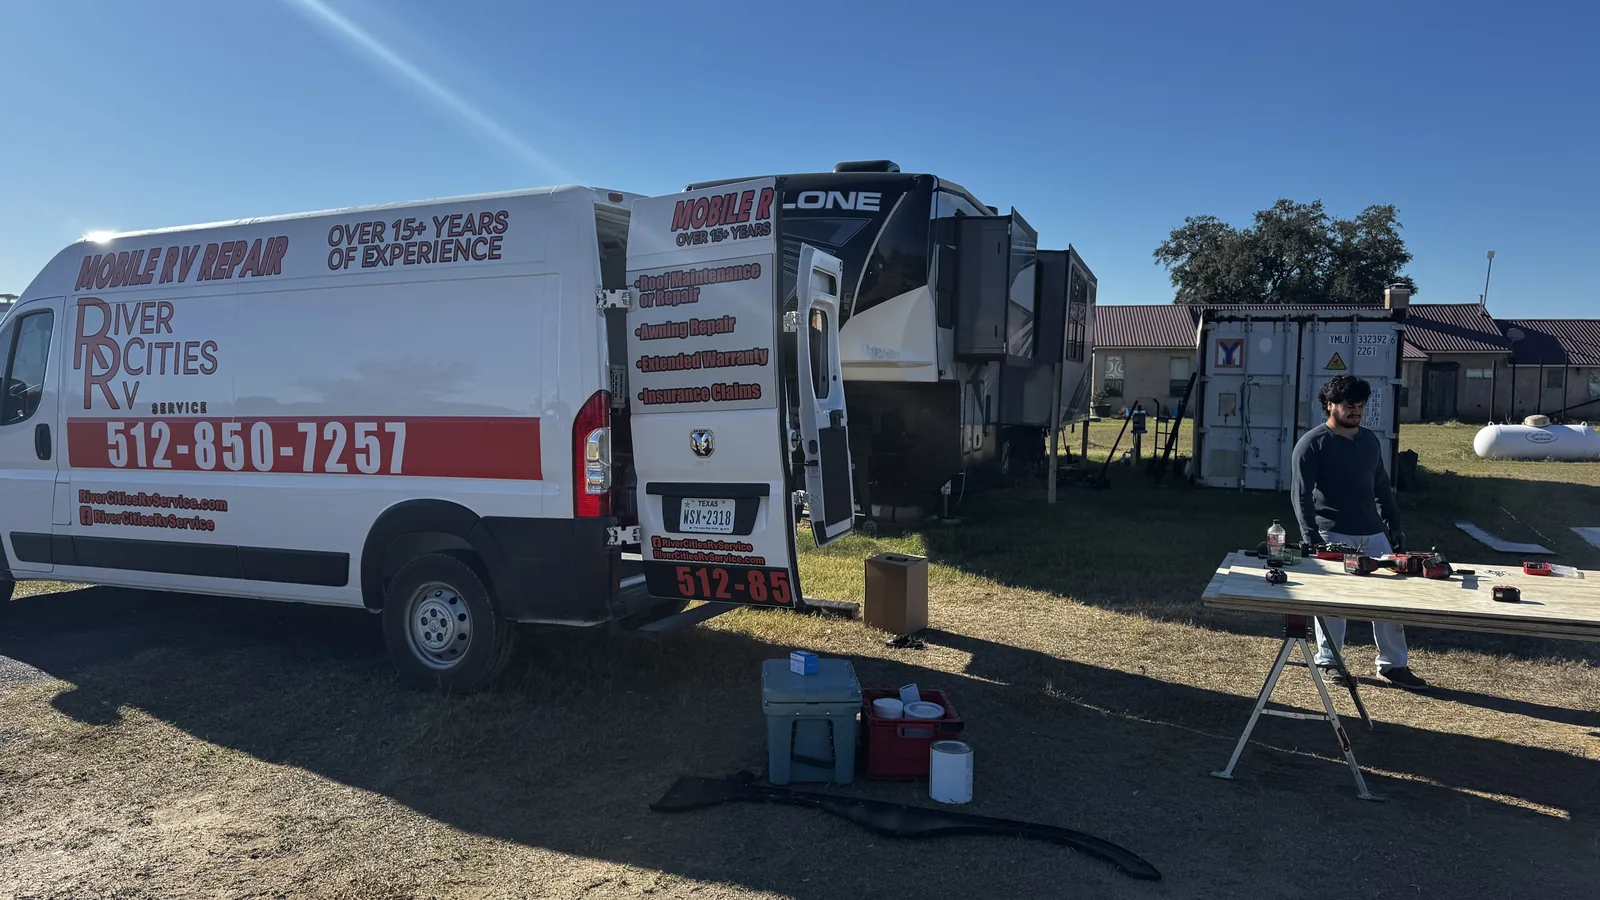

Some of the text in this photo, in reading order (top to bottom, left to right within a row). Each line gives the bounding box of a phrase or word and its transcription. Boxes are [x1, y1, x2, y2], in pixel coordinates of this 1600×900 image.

[671, 187, 775, 232] MOBILE R
[328, 210, 509, 247] OVER 15+ YEARS
[676, 221, 772, 247] OVER 15+ YEARS
[74, 236, 288, 291] MOBILE RV REPAIR
[327, 236, 503, 271] OF EXPERIENCE
[639, 262, 761, 292] Roof Maintenance
[639, 286, 700, 308] or Repair
[73, 297, 174, 369] RIVER
[639, 315, 736, 340] Awning Repair
[1330, 335, 1396, 345] YMLU 332392 6
[122, 336, 218, 376] CITIES
[641, 347, 769, 373] Extended Warranty
[1357, 346, 1376, 356] 22G1
[643, 386, 711, 405] Insurance
[711, 382, 761, 401] Claims
[151, 401, 207, 414] SERVICE
[106, 421, 407, 474] 512-850-7257
[79, 489, 228, 512] RiverCitiesRvService.com
[94, 509, 215, 531] RiverCitiesRvService
[706, 510, 731, 526] 2318
[653, 549, 766, 565] RiverCitiesRvService.com
[661, 537, 753, 552] RiverCitiesRvService
[676, 566, 791, 604] 512-85
